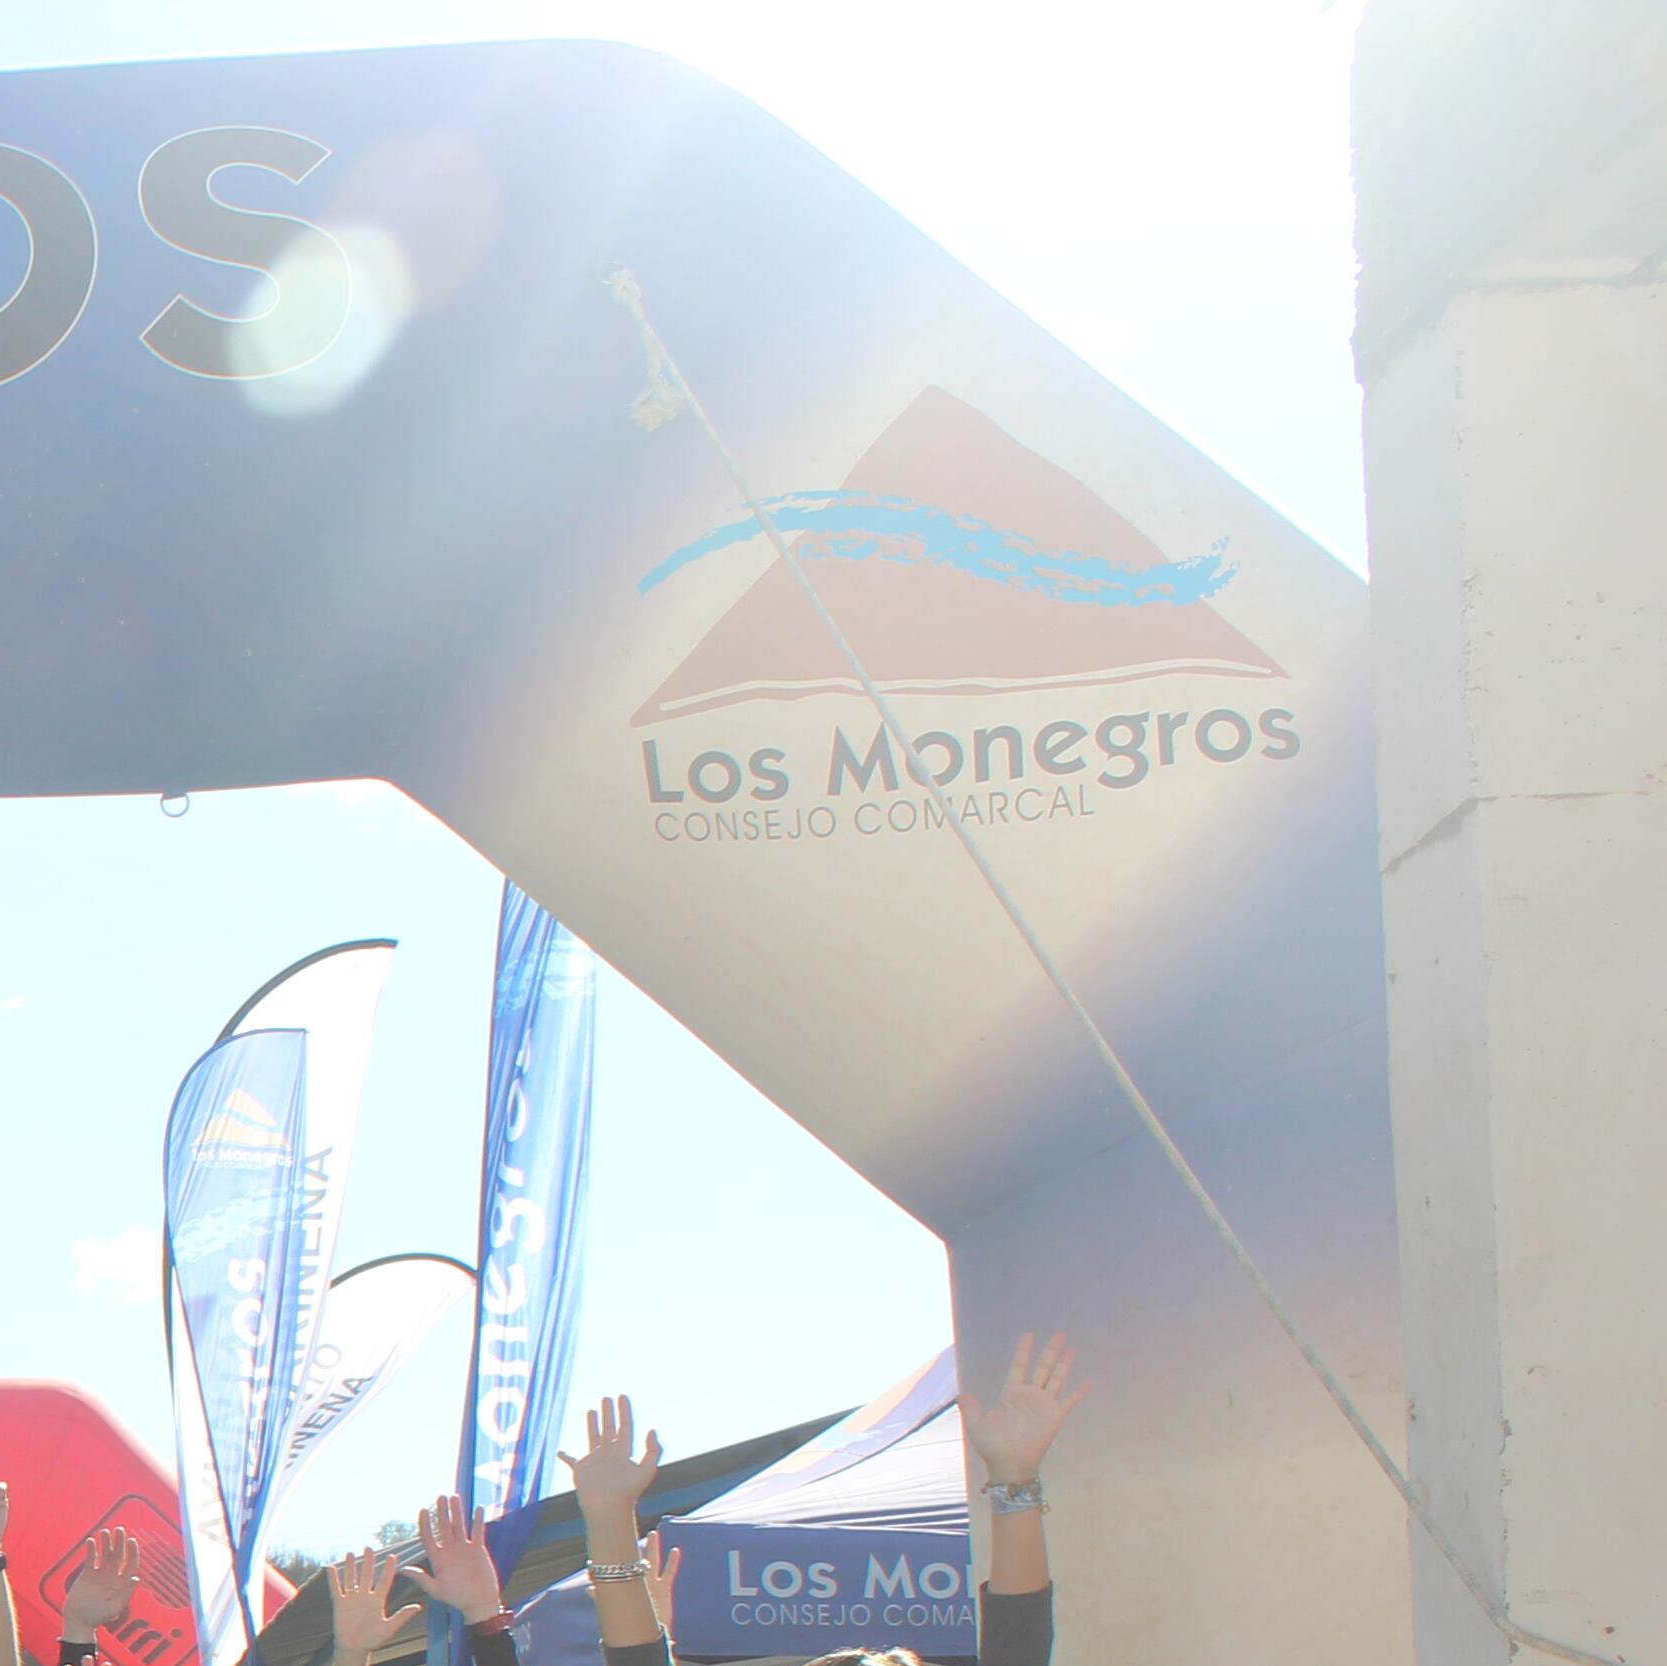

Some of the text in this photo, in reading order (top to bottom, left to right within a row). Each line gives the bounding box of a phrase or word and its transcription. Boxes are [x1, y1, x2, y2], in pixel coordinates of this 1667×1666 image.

[643, 708, 1302, 804] Los Monegros
[654, 784, 1095, 842] CONSEJO COMARCAL
[728, 1550, 839, 1599] Los
[731, 1603, 872, 1626] CONSEJO
